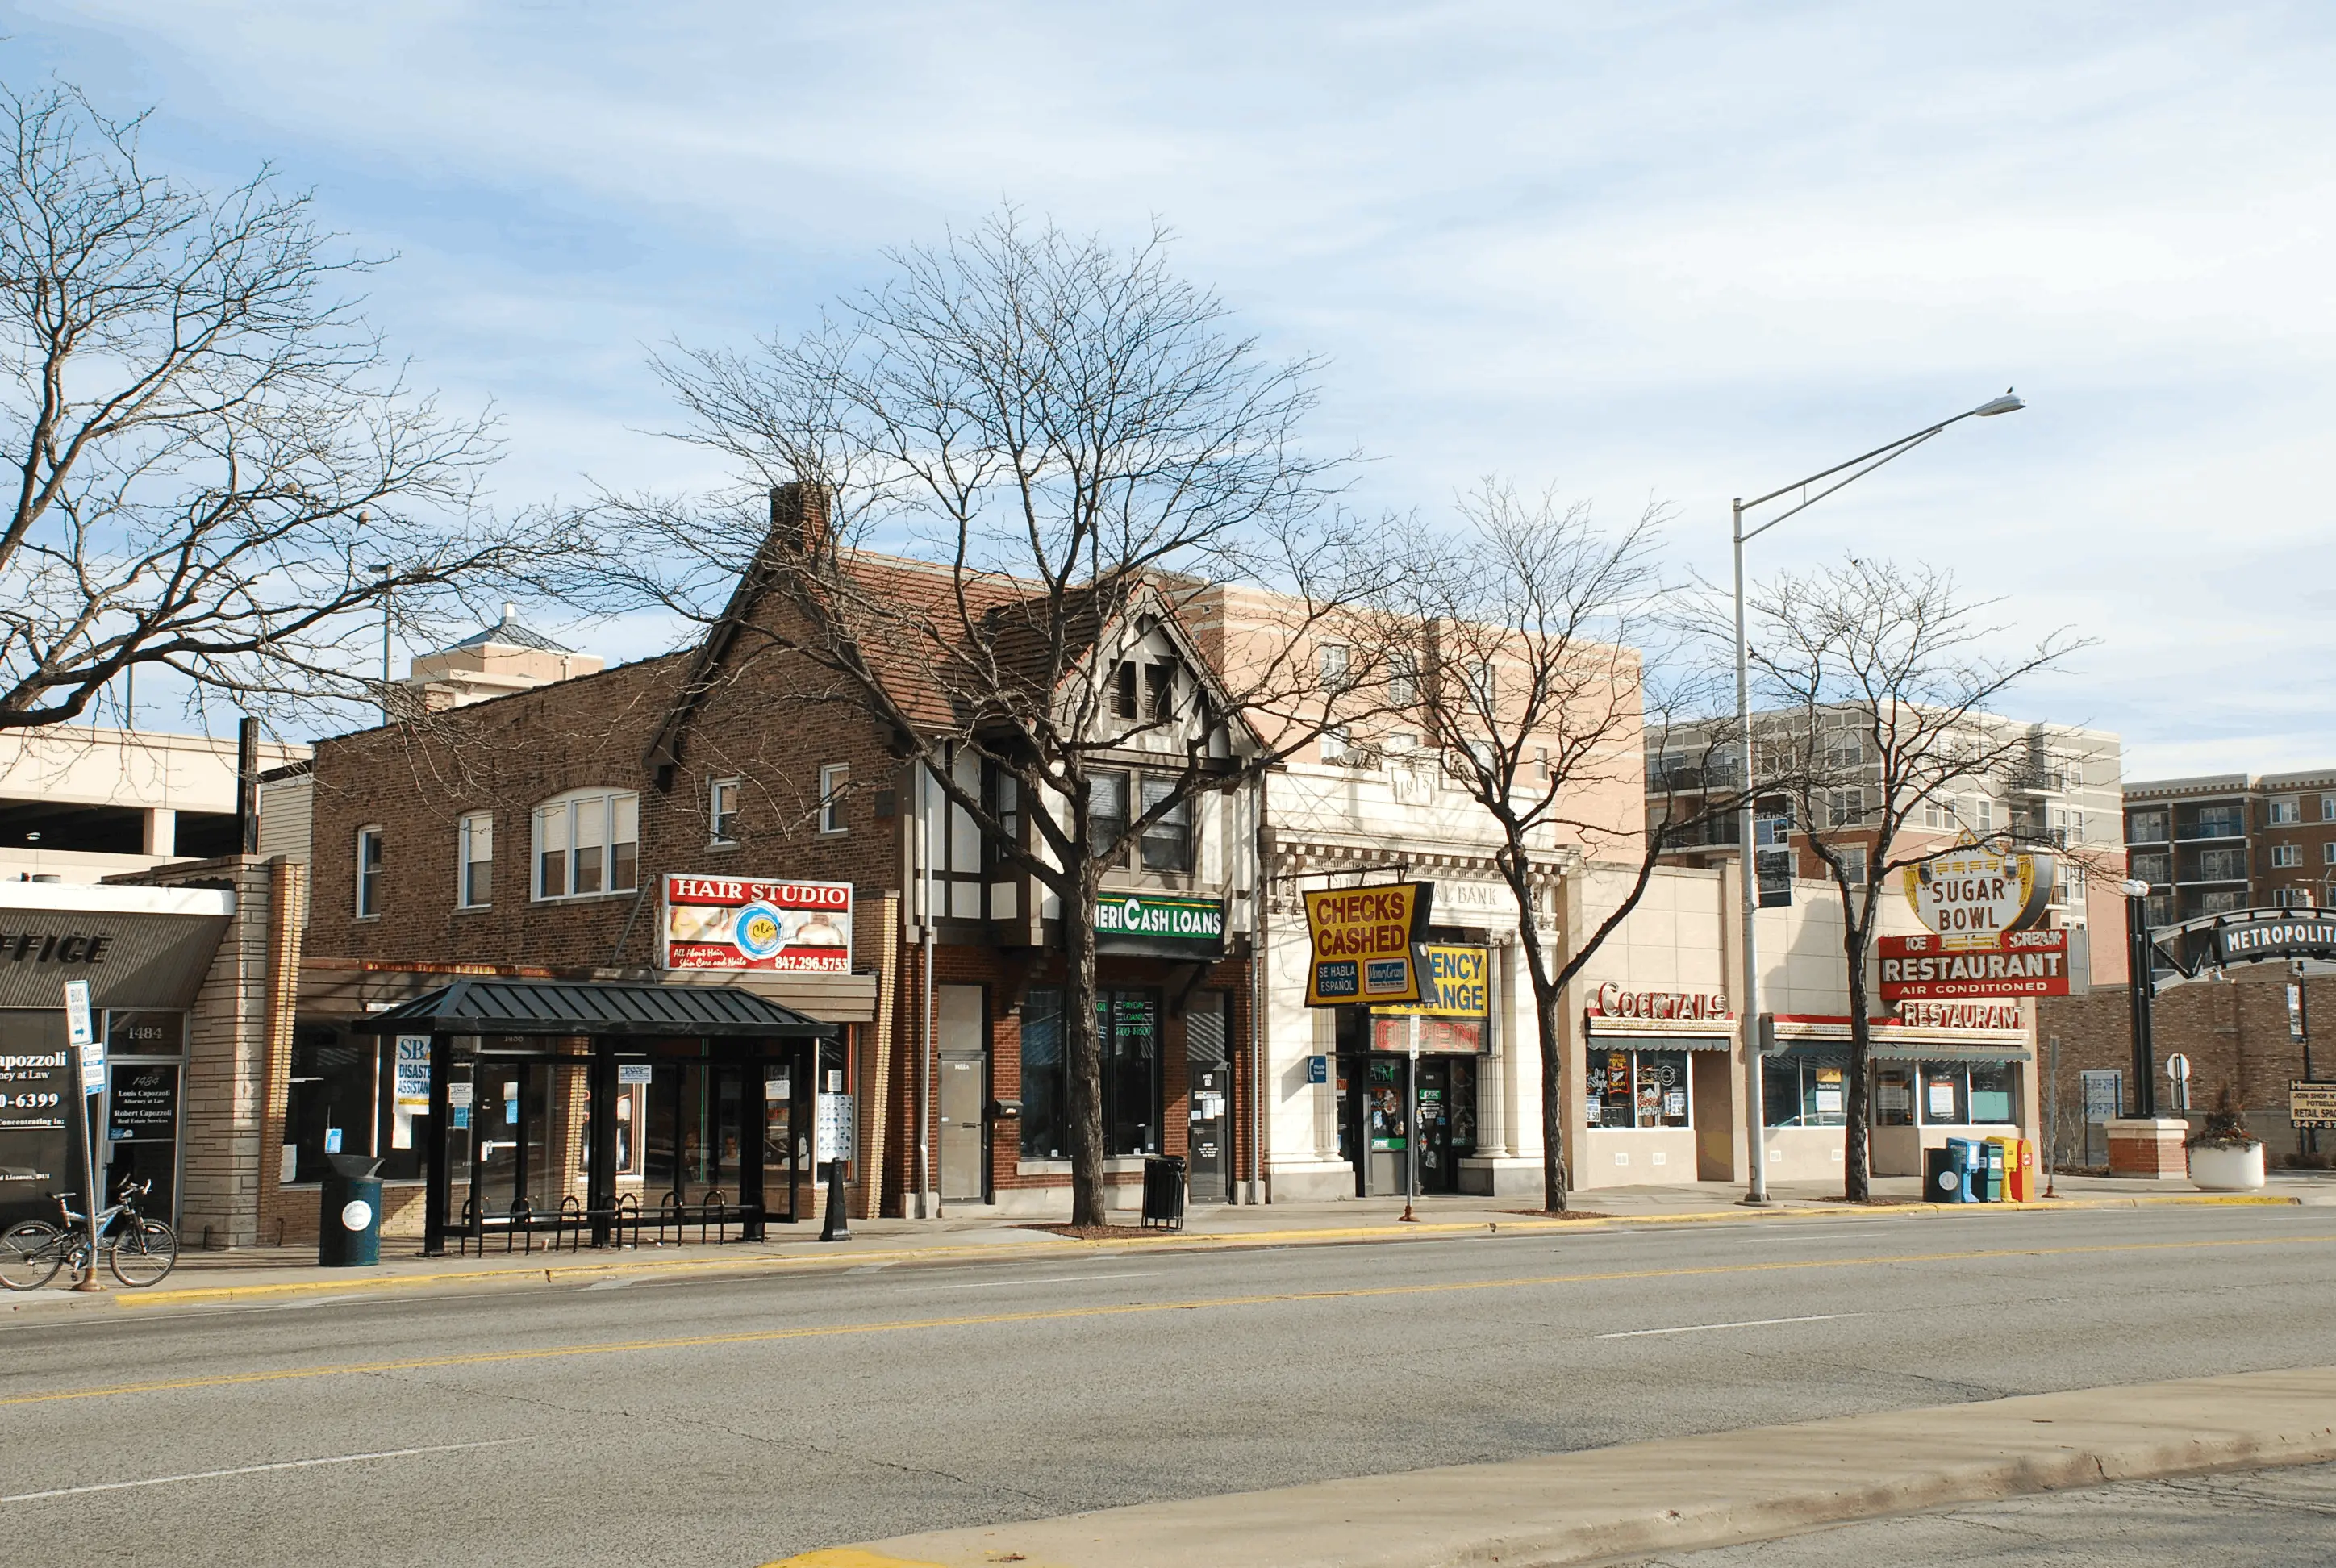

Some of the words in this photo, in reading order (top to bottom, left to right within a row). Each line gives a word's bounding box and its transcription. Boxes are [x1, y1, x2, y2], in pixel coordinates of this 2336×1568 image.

[677, 880, 743, 899] HAIR
[751, 883, 846, 904] STUDIO
[1458, 886, 1497, 905] BANK
[1932, 878, 2004, 903] SUGAR
[1316, 892, 1405, 925] CHECKS
[1173, 910, 1221, 935] LOANS
[1939, 907, 2000, 931] BOWL
[1317, 924, 1406, 957] CASHED
[1905, 936, 1928, 951] ICE
[2227, 924, 2336, 952] METROPOLIT
[674, 948, 685, 957] All
[686, 947, 706, 957] About
[679, 958, 695, 968] Skin
[696, 959, 712, 968] Care
[713, 958, 727, 967] and
[728, 957, 747, 966] Nails
[775, 956, 848, 970] 847.296.5753
[1432, 953, 1483, 980] ENCY
[1883, 953, 2063, 982] RESTAURANT
[1319, 967, 1329, 978] SE
[1331, 965, 1355, 977] HABLA
[1320, 978, 1354, 992] ESPAÑOL
[1900, 986, 1926, 995] AIR
[1935, 982, 2047, 994] CONDITIONED
[1904, 1002, 2025, 1029] RESTAURANT
[128, 1027, 162, 1039] 1484
[29, 1070, 49, 1078] Law
[1594, 1067, 1606, 1078] Old
[138, 1090, 171, 1098] Capozzoli
[140, 1110, 172, 1118] Capozzoli
[2294, 1108, 2318, 1117] RETAIL
[53, 1117, 65, 1125] in:
